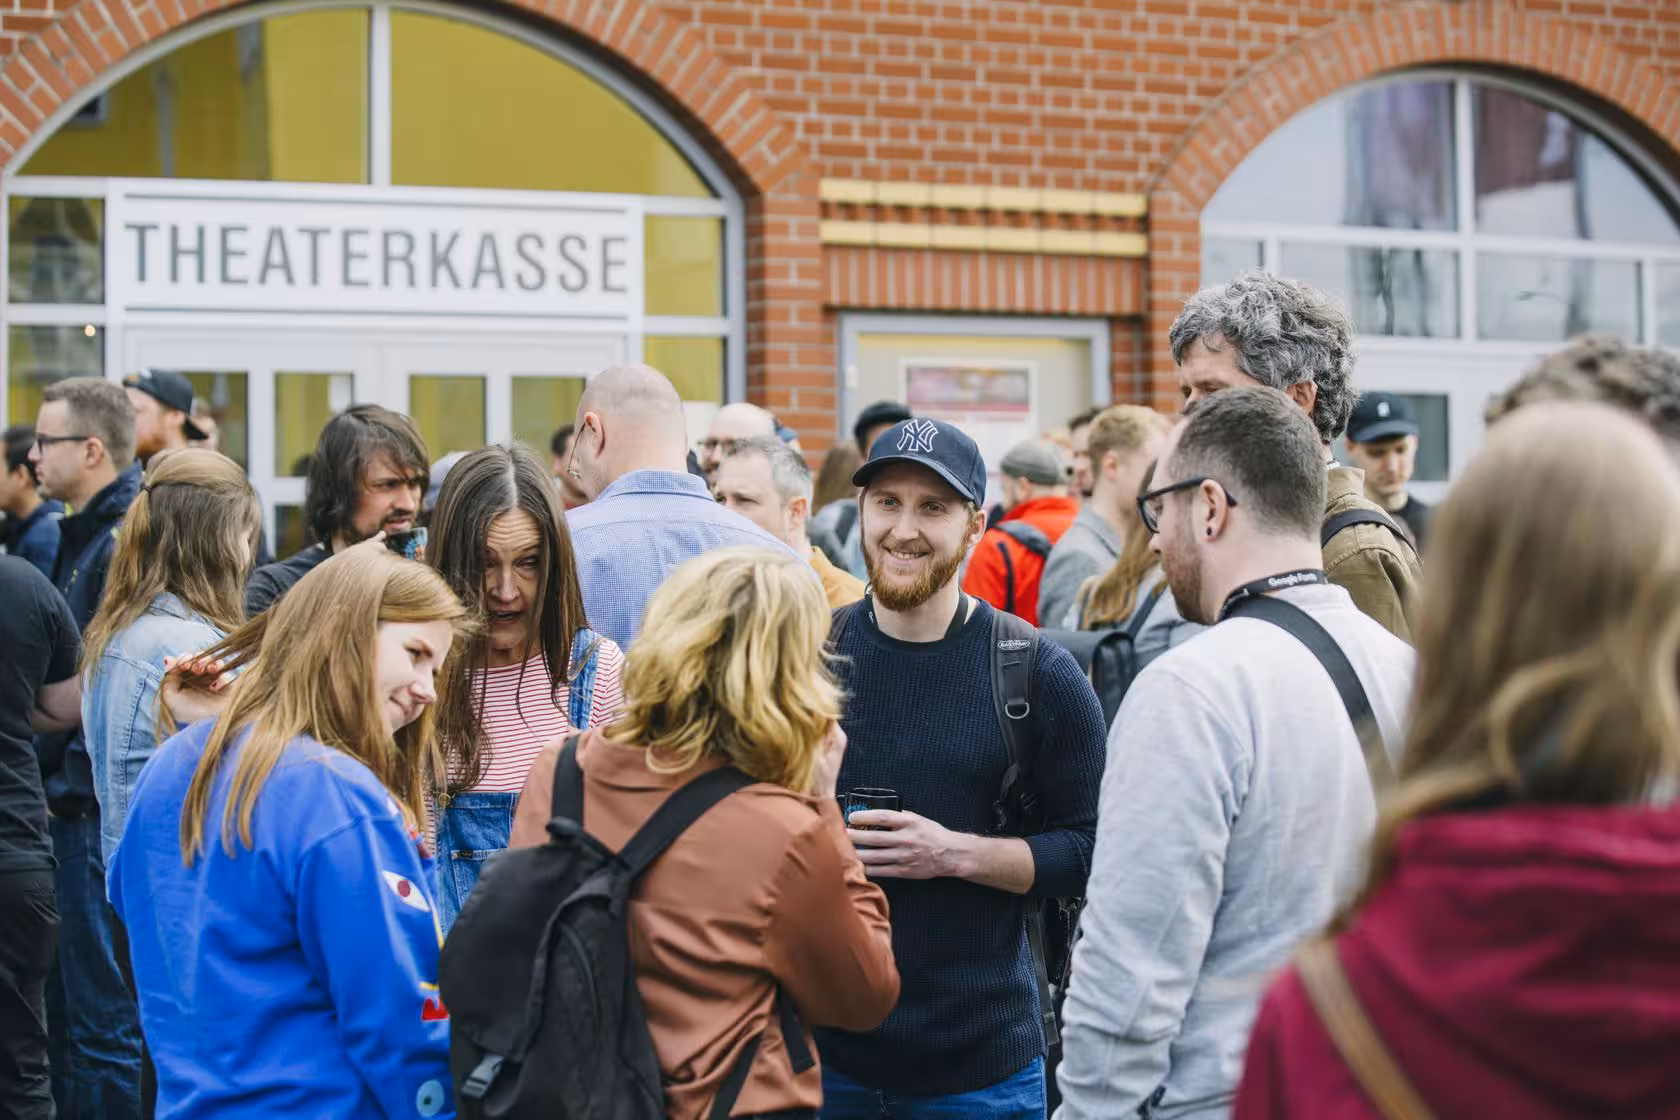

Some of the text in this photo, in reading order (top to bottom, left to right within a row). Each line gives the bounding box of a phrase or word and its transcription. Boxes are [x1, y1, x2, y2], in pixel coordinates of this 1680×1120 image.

[124, 223, 628, 293] THEATERKASSE
[896, 419, 939, 453] NY
[1268, 574, 1298, 587] Google
